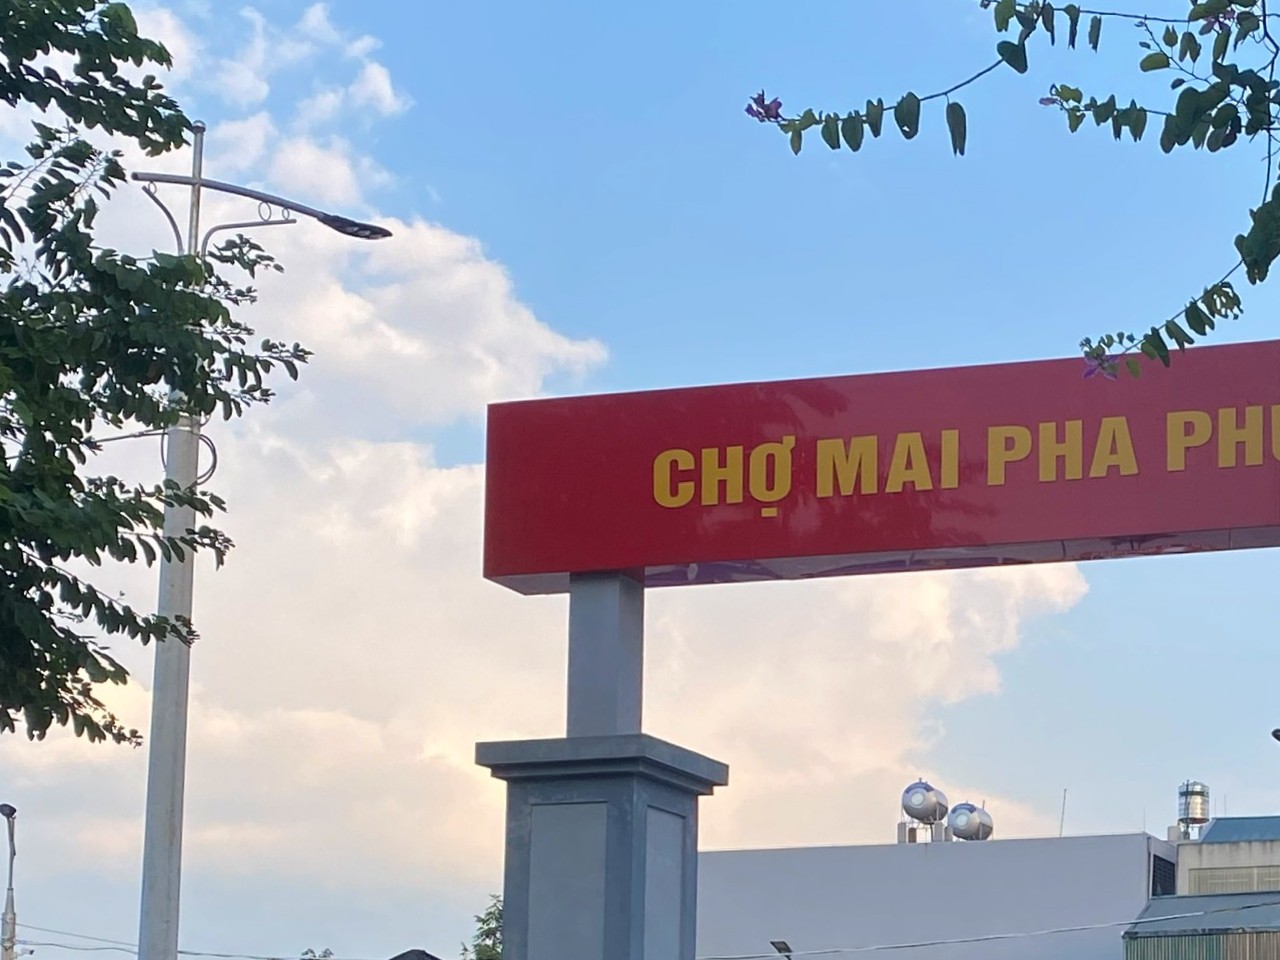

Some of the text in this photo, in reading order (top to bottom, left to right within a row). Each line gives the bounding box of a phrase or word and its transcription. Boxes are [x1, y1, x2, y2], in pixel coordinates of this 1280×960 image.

[652, 435, 796, 517] CHỢ
[816, 428, 959, 499] MAI
[986, 415, 1139, 486] PHA
